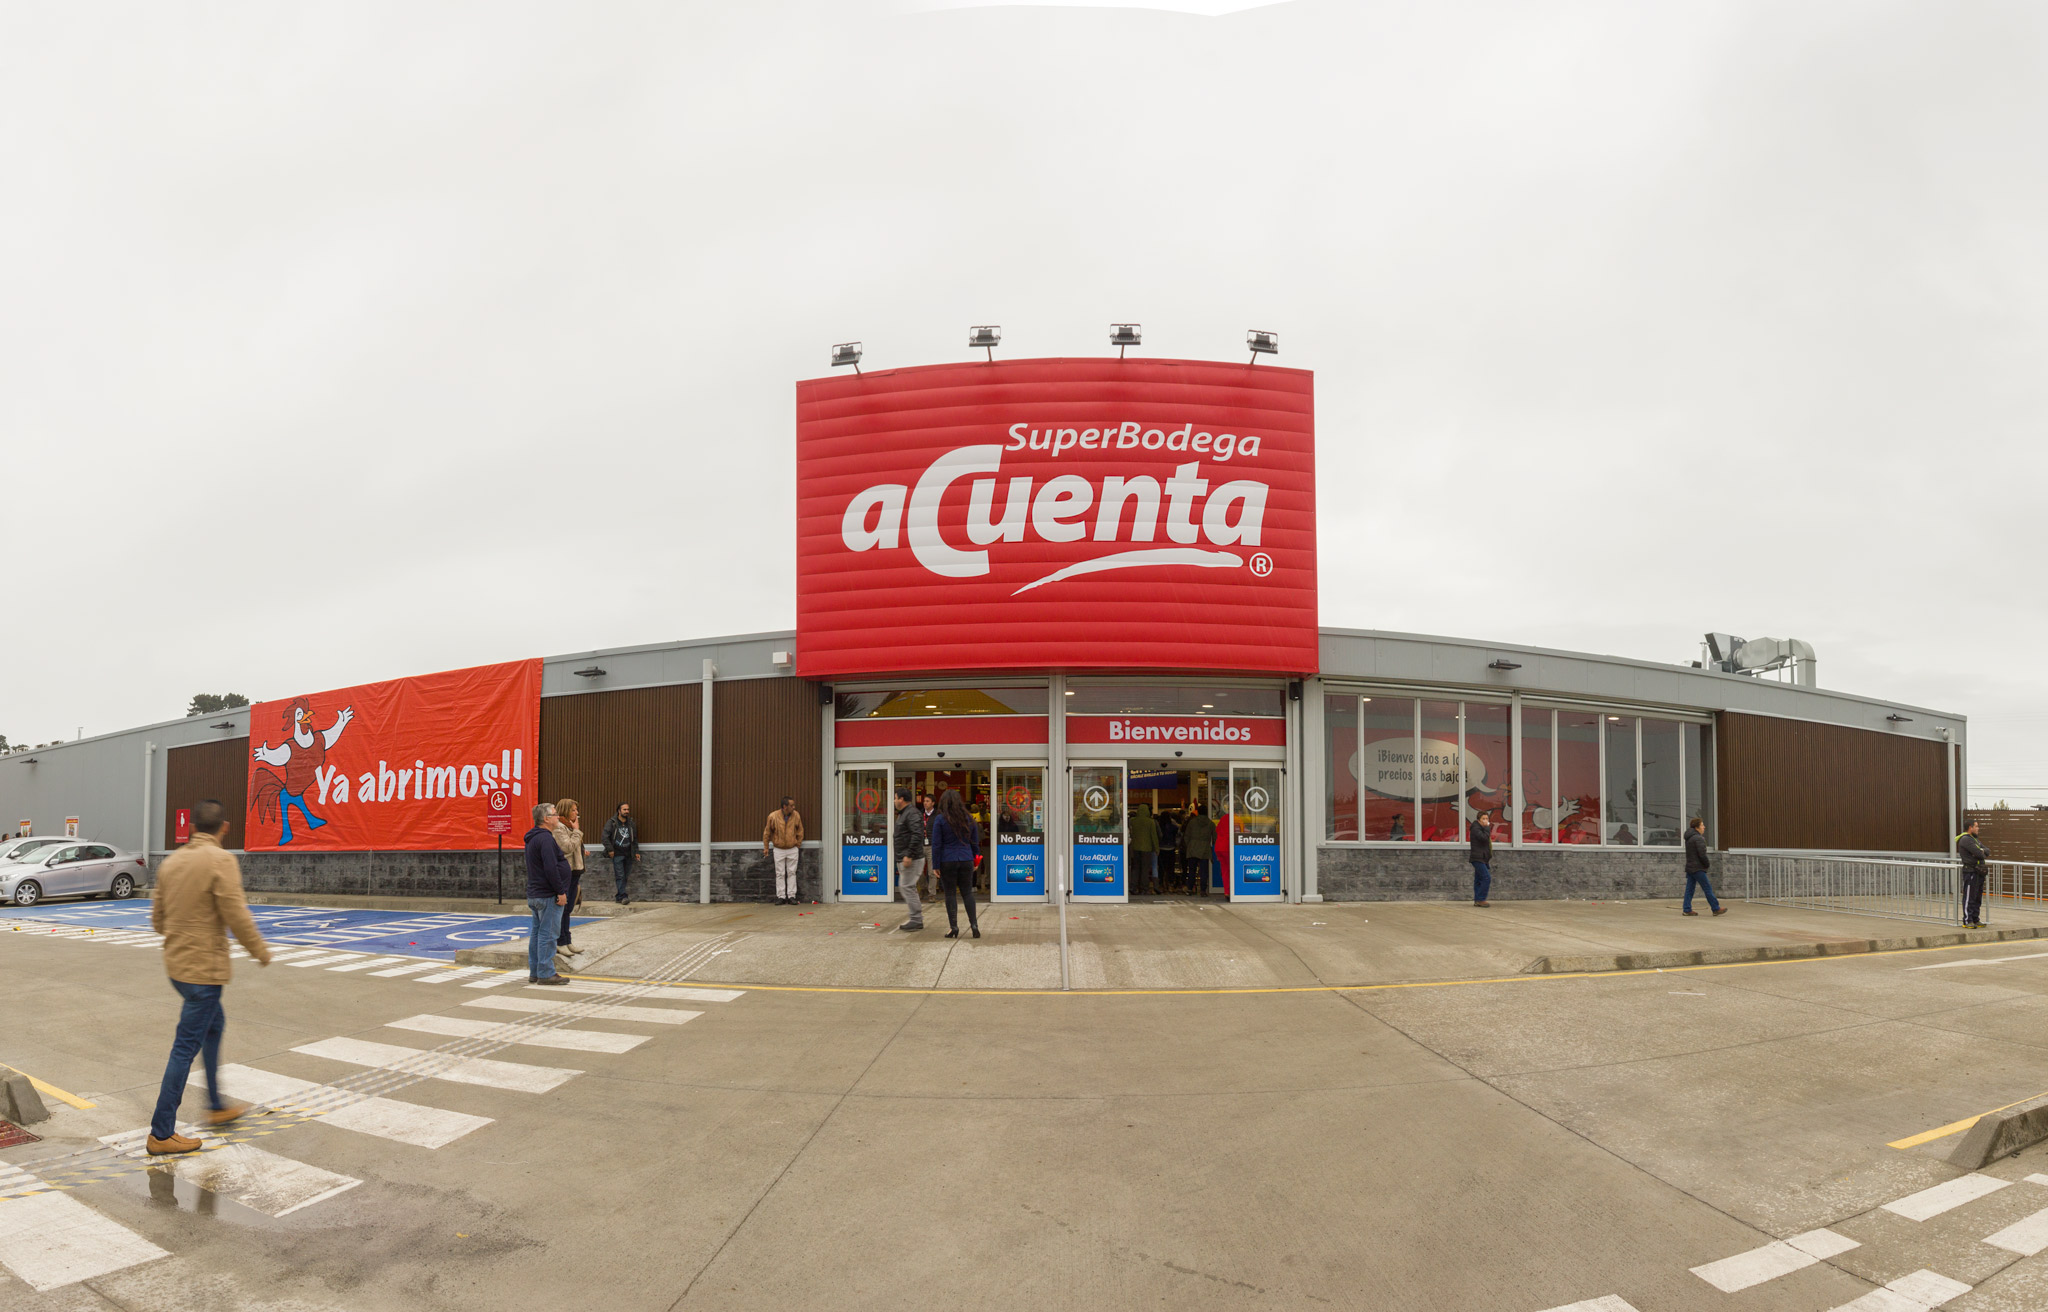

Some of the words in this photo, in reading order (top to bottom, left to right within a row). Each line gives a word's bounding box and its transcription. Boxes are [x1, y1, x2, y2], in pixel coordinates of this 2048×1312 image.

[1005, 421, 1261, 461] SuperBodega
[842, 444, 1269, 578] aCuenta
[1109, 720, 1251, 741] Bienvenidos
[1378, 749, 1439, 765] ¡Bienveidos
[1442, 755, 1449, 766] a
[315, 764, 350, 806] Ya
[358, 748, 522, 803] abrimos!!
[1378, 768, 1413, 782] precios
[1441, 770, 1468, 785] bajo!
[845, 835, 858, 844] No
[860, 835, 884, 844] Pasar
[1000, 834, 1013, 843] No
[1015, 834, 1040, 843] Pasar
[1238, 834, 1275, 844] Entrada
